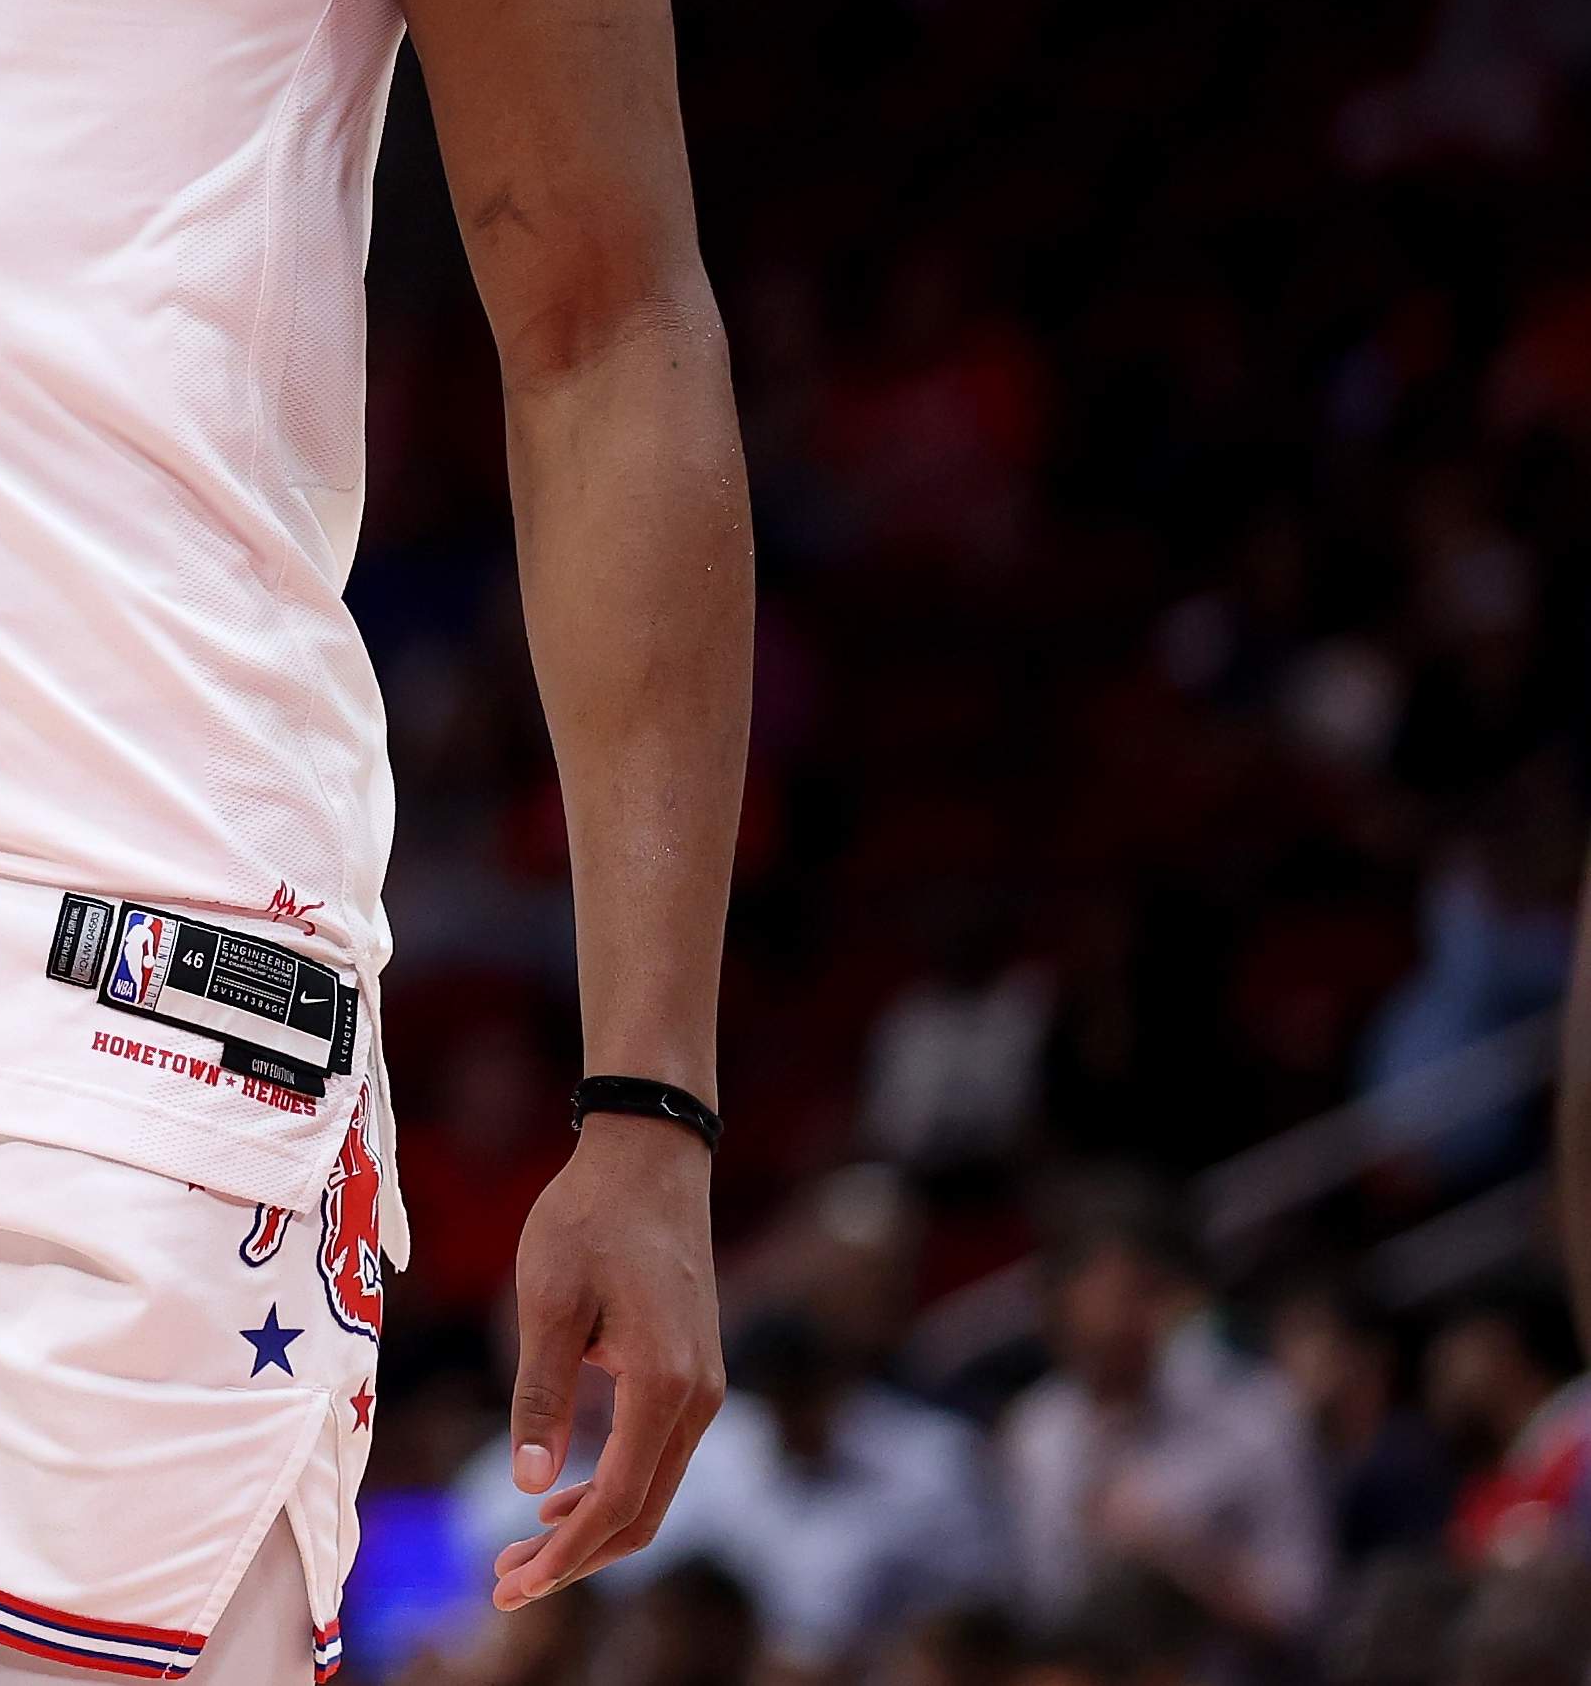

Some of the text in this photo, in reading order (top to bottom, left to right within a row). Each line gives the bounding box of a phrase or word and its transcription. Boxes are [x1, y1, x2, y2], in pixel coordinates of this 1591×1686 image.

[144, 920, 176, 1008] AUTHENTICS
[182, 949, 205, 969] 46
[221, 940, 294, 973] ENGINEERED
[114, 979, 133, 998] NBA
[91, 1031, 221, 1087] HOMETOWN
[251, 1058, 296, 1086] CITY EDITION
[241, 1075, 317, 1117] HEROES
